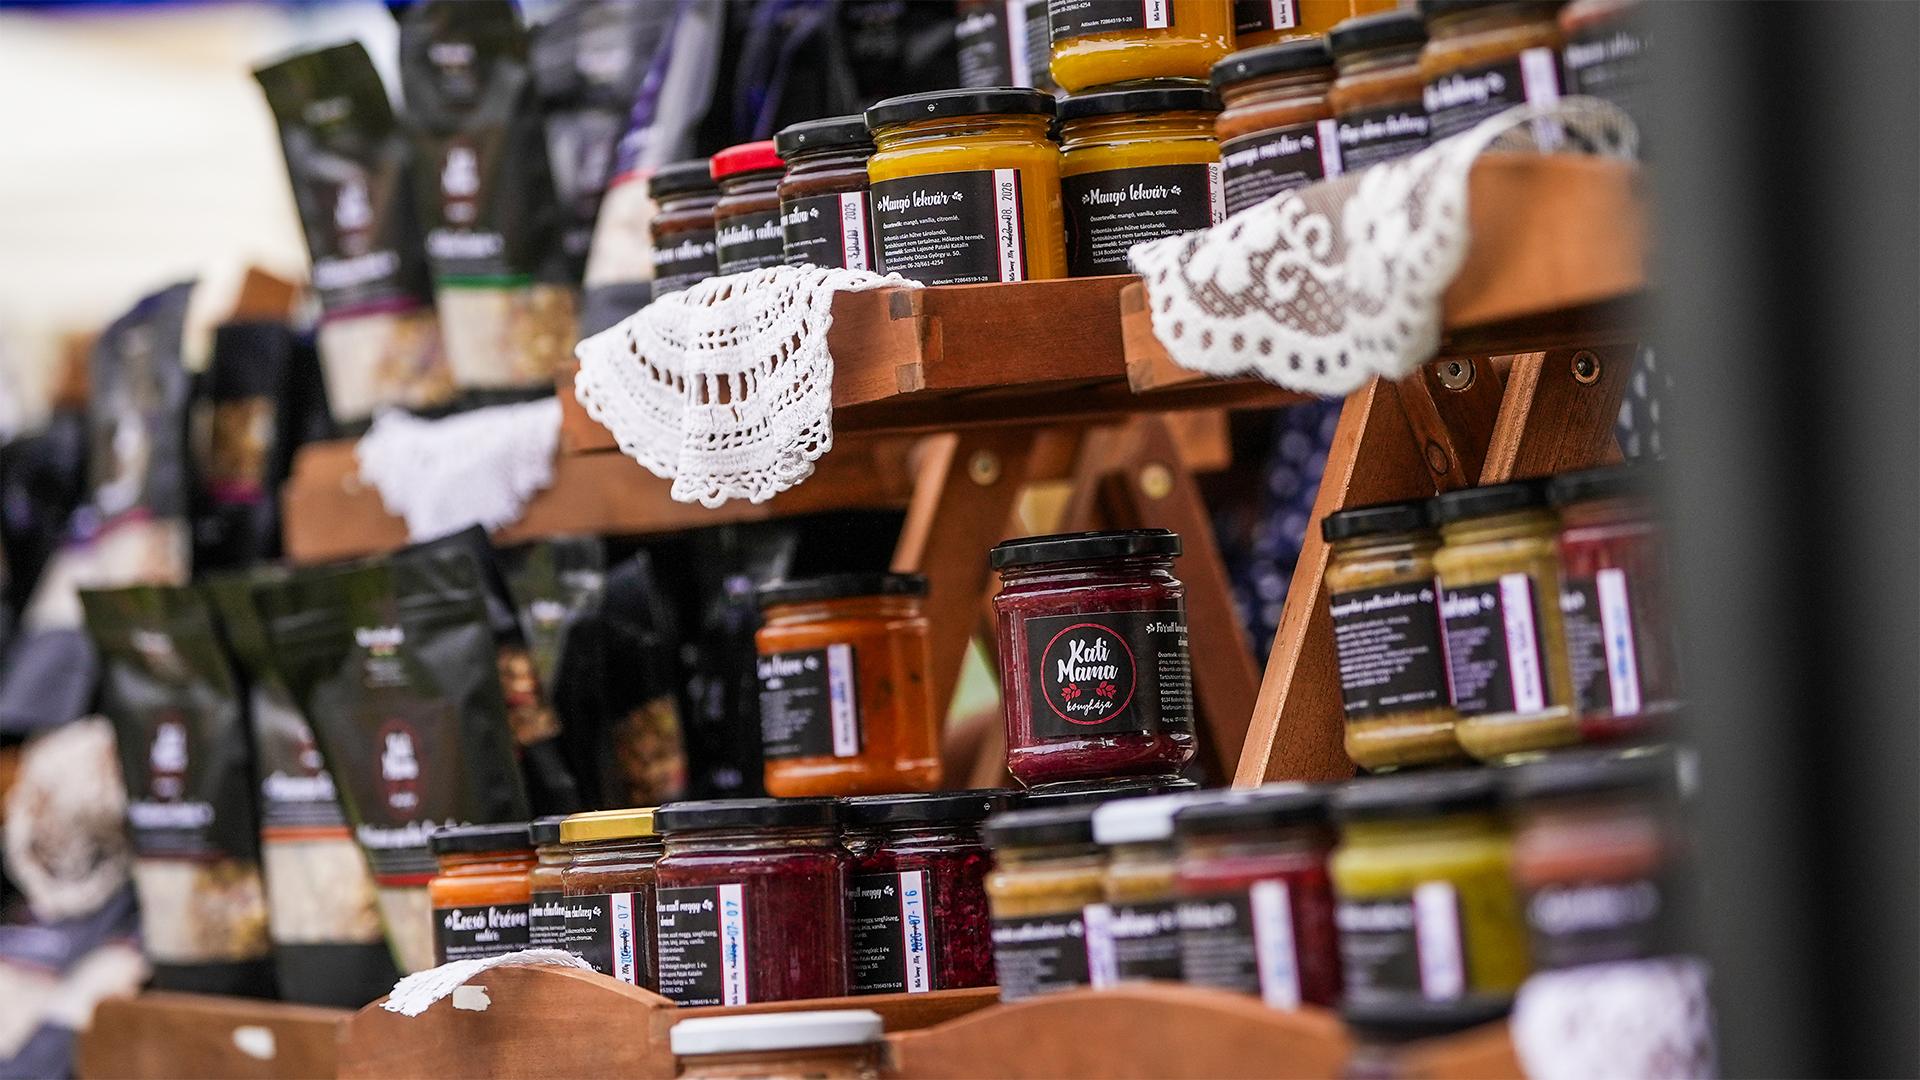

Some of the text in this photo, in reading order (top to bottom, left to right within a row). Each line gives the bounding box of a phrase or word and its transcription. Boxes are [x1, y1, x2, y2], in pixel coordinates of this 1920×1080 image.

[882, 190, 950, 214] Mangó lekvár
[1001, 182, 1012, 201] 2026
[1090, 183, 1170, 206] Mangó lekvár
[845, 202, 856, 220] 2025
[1068, 637, 1110, 664] Kati
[1056, 659, 1118, 683] Mama
[1066, 698, 1113, 716] konyhája
